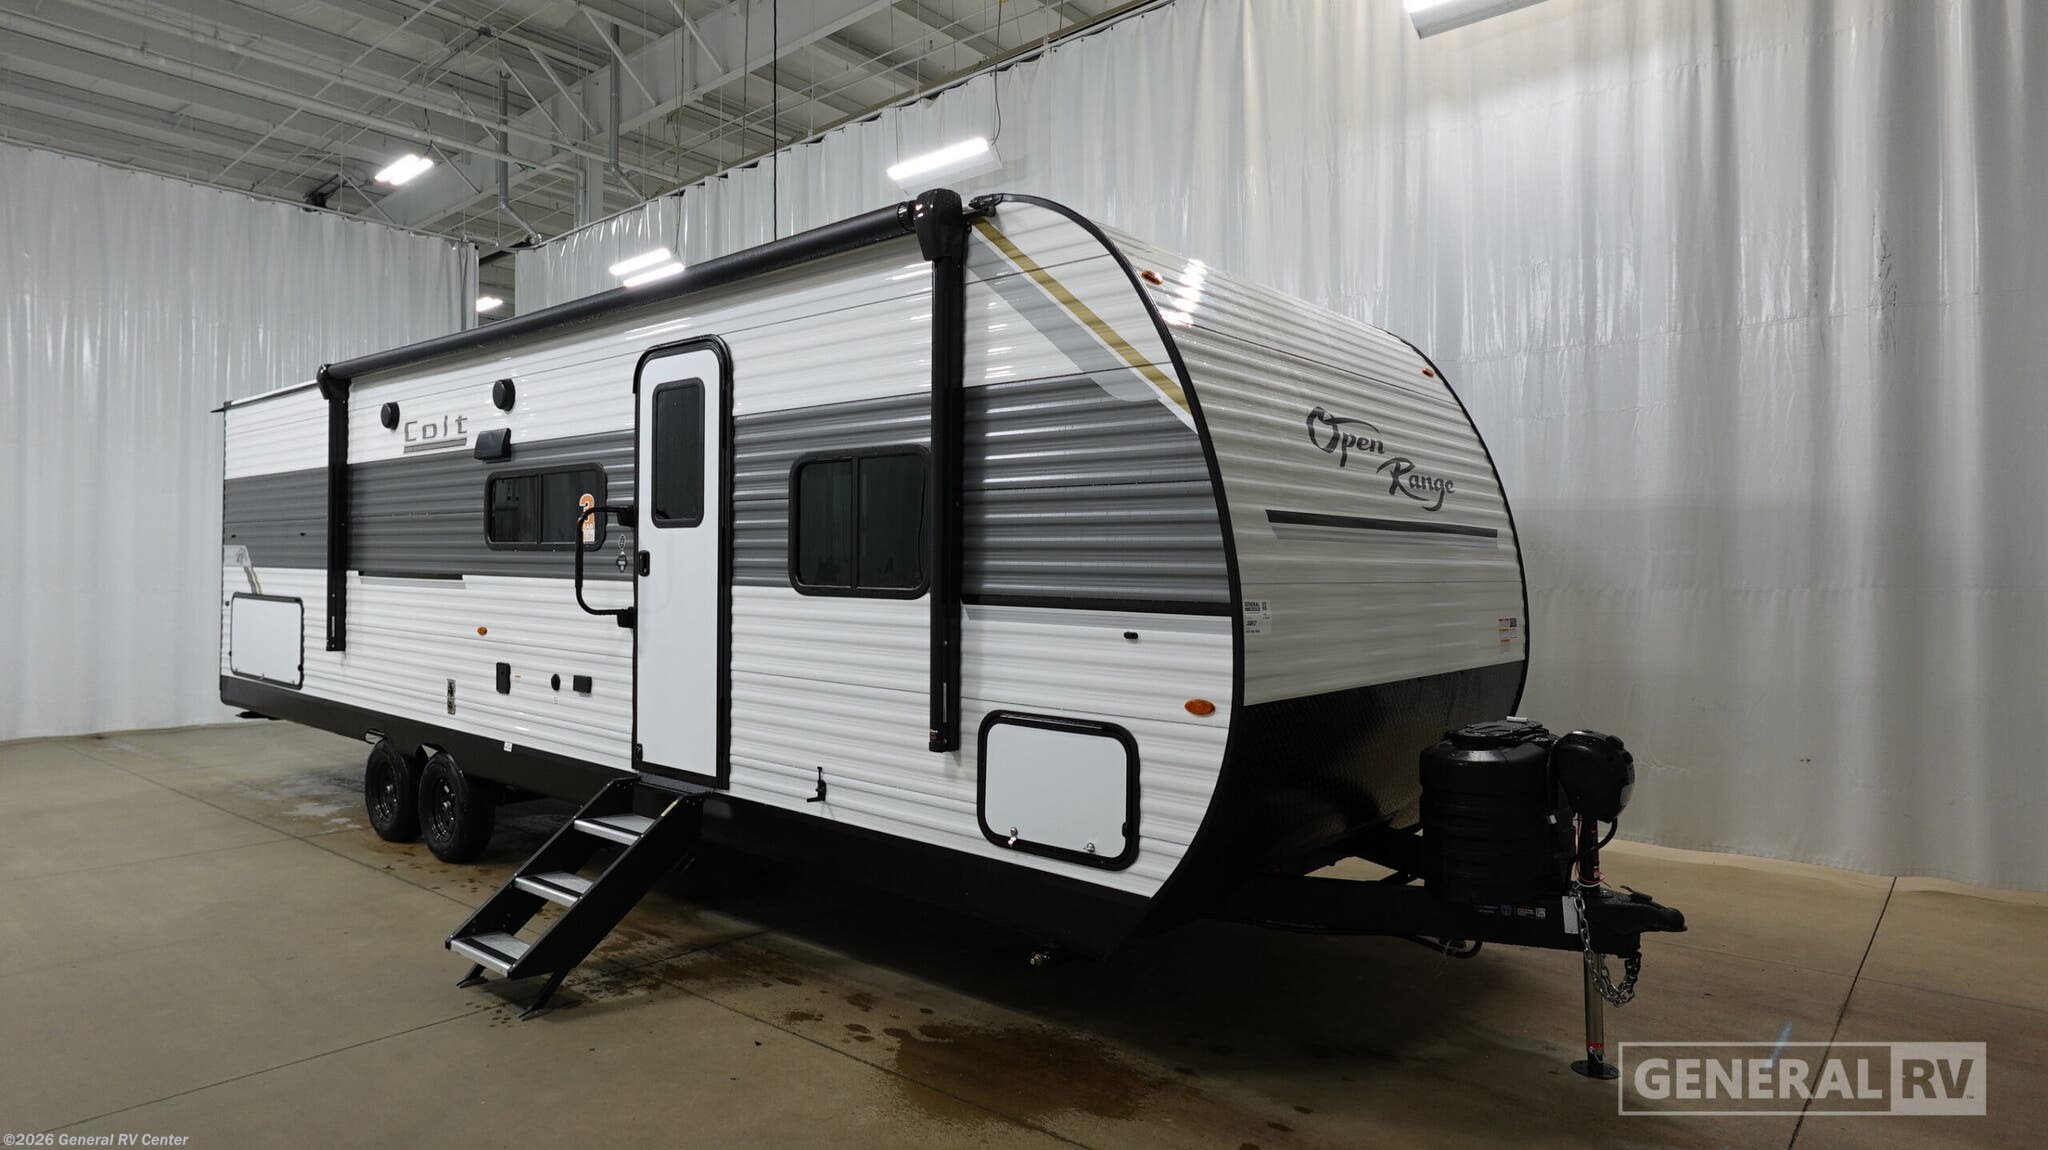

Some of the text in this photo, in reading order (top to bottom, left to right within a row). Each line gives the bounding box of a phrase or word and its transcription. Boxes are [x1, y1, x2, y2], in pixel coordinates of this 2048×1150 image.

[404, 415, 468, 442] Colt
[1306, 406, 1385, 468] Open
[1376, 456, 1455, 512] Range
